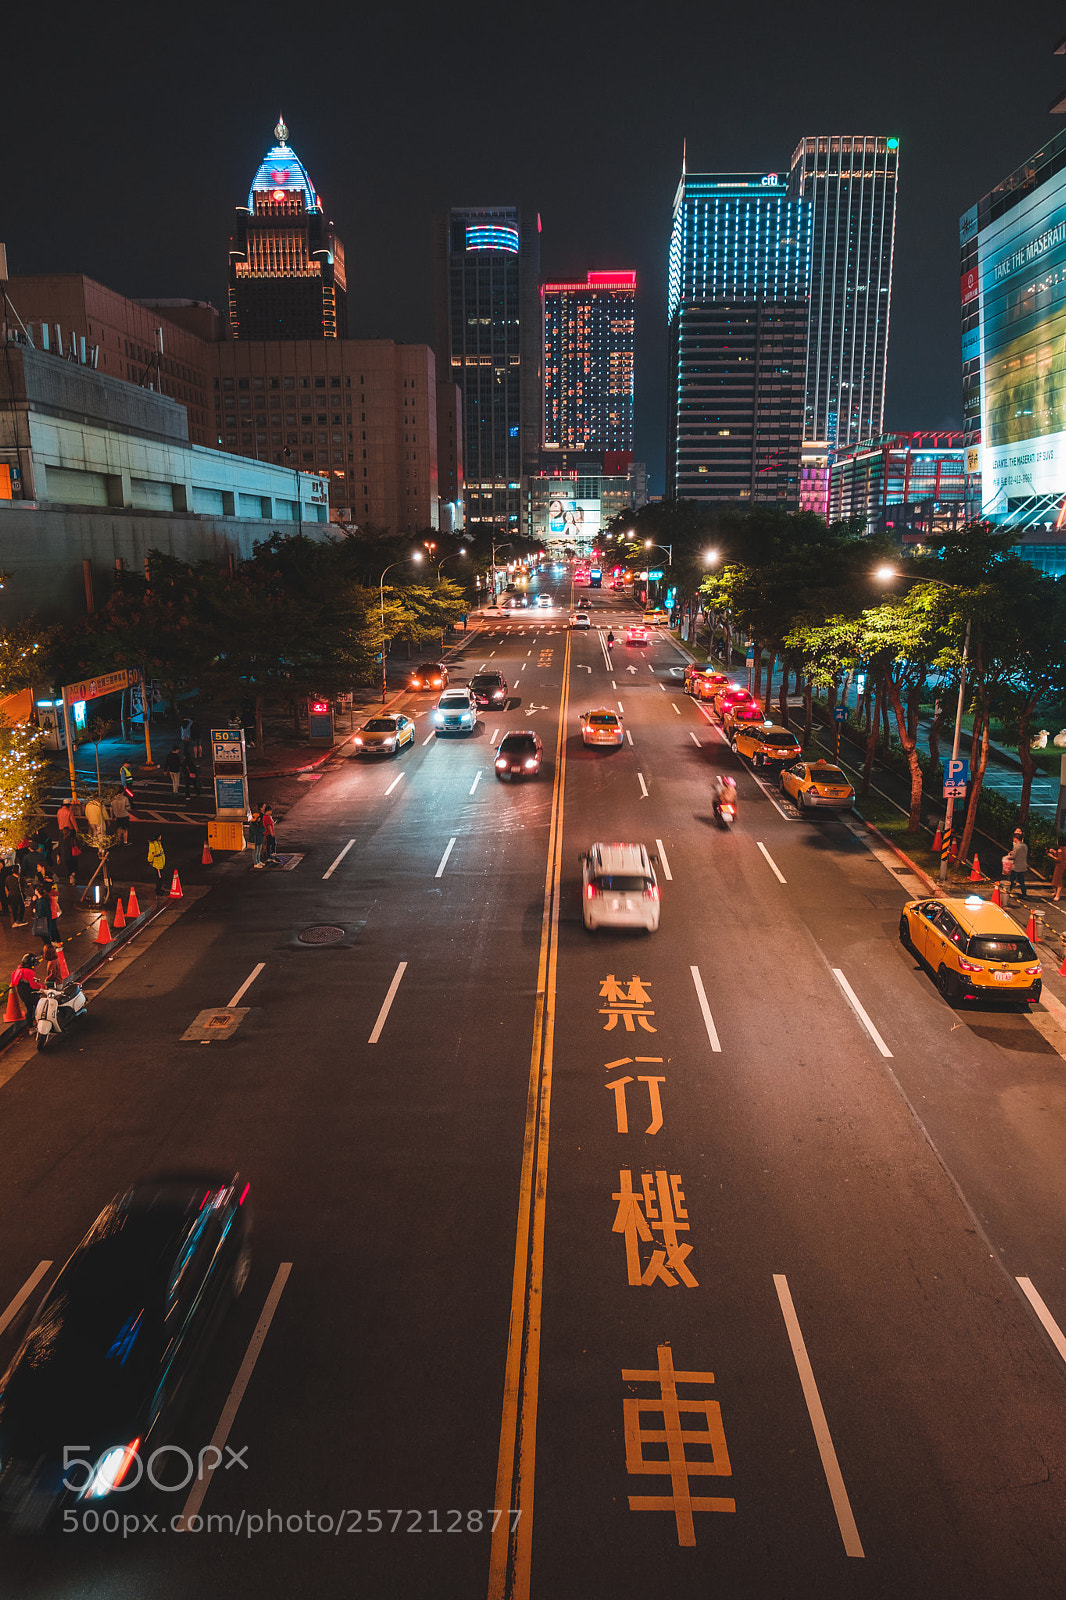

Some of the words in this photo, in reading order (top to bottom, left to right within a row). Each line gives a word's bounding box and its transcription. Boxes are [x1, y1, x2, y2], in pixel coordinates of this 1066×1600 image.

[761, 173, 778, 186] citi
[994, 257, 1011, 280] TAKE
[1011, 247, 1025, 270] THE
[1026, 220, 1066, 261] MASERATI
[128, 668, 138, 684] 50
[215, 732, 229, 741] 50
[215, 745, 224, 755] P
[948, 760, 964, 779] P
[598, 973, 737, 1548] 禁行機車
